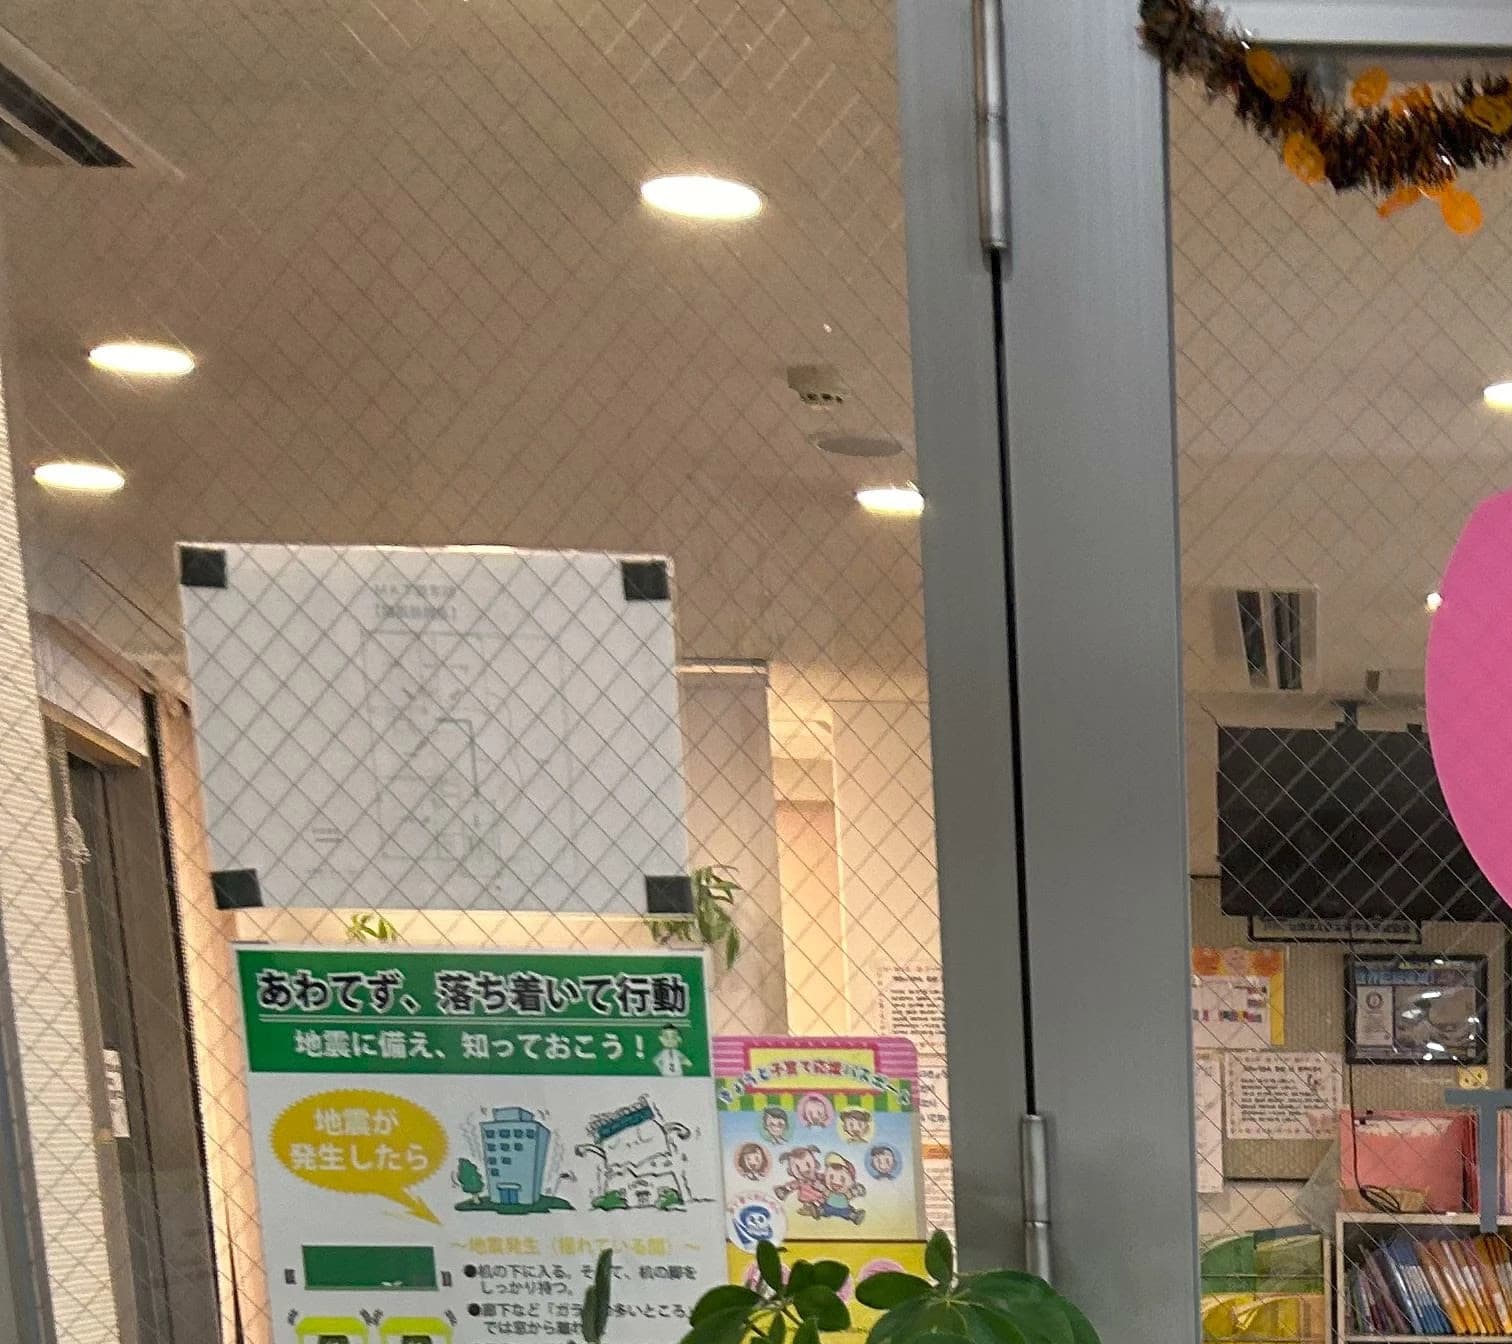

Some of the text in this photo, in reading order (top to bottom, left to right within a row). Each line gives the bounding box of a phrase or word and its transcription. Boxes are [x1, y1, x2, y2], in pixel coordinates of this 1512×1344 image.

[257, 967, 689, 1016] あわてず、落ち着いて行動
[294, 1029, 647, 1060] 地震に備え、知っておこう！
[313, 1108, 399, 1138] 地震が
[287, 1142, 429, 1173] 発生したら
